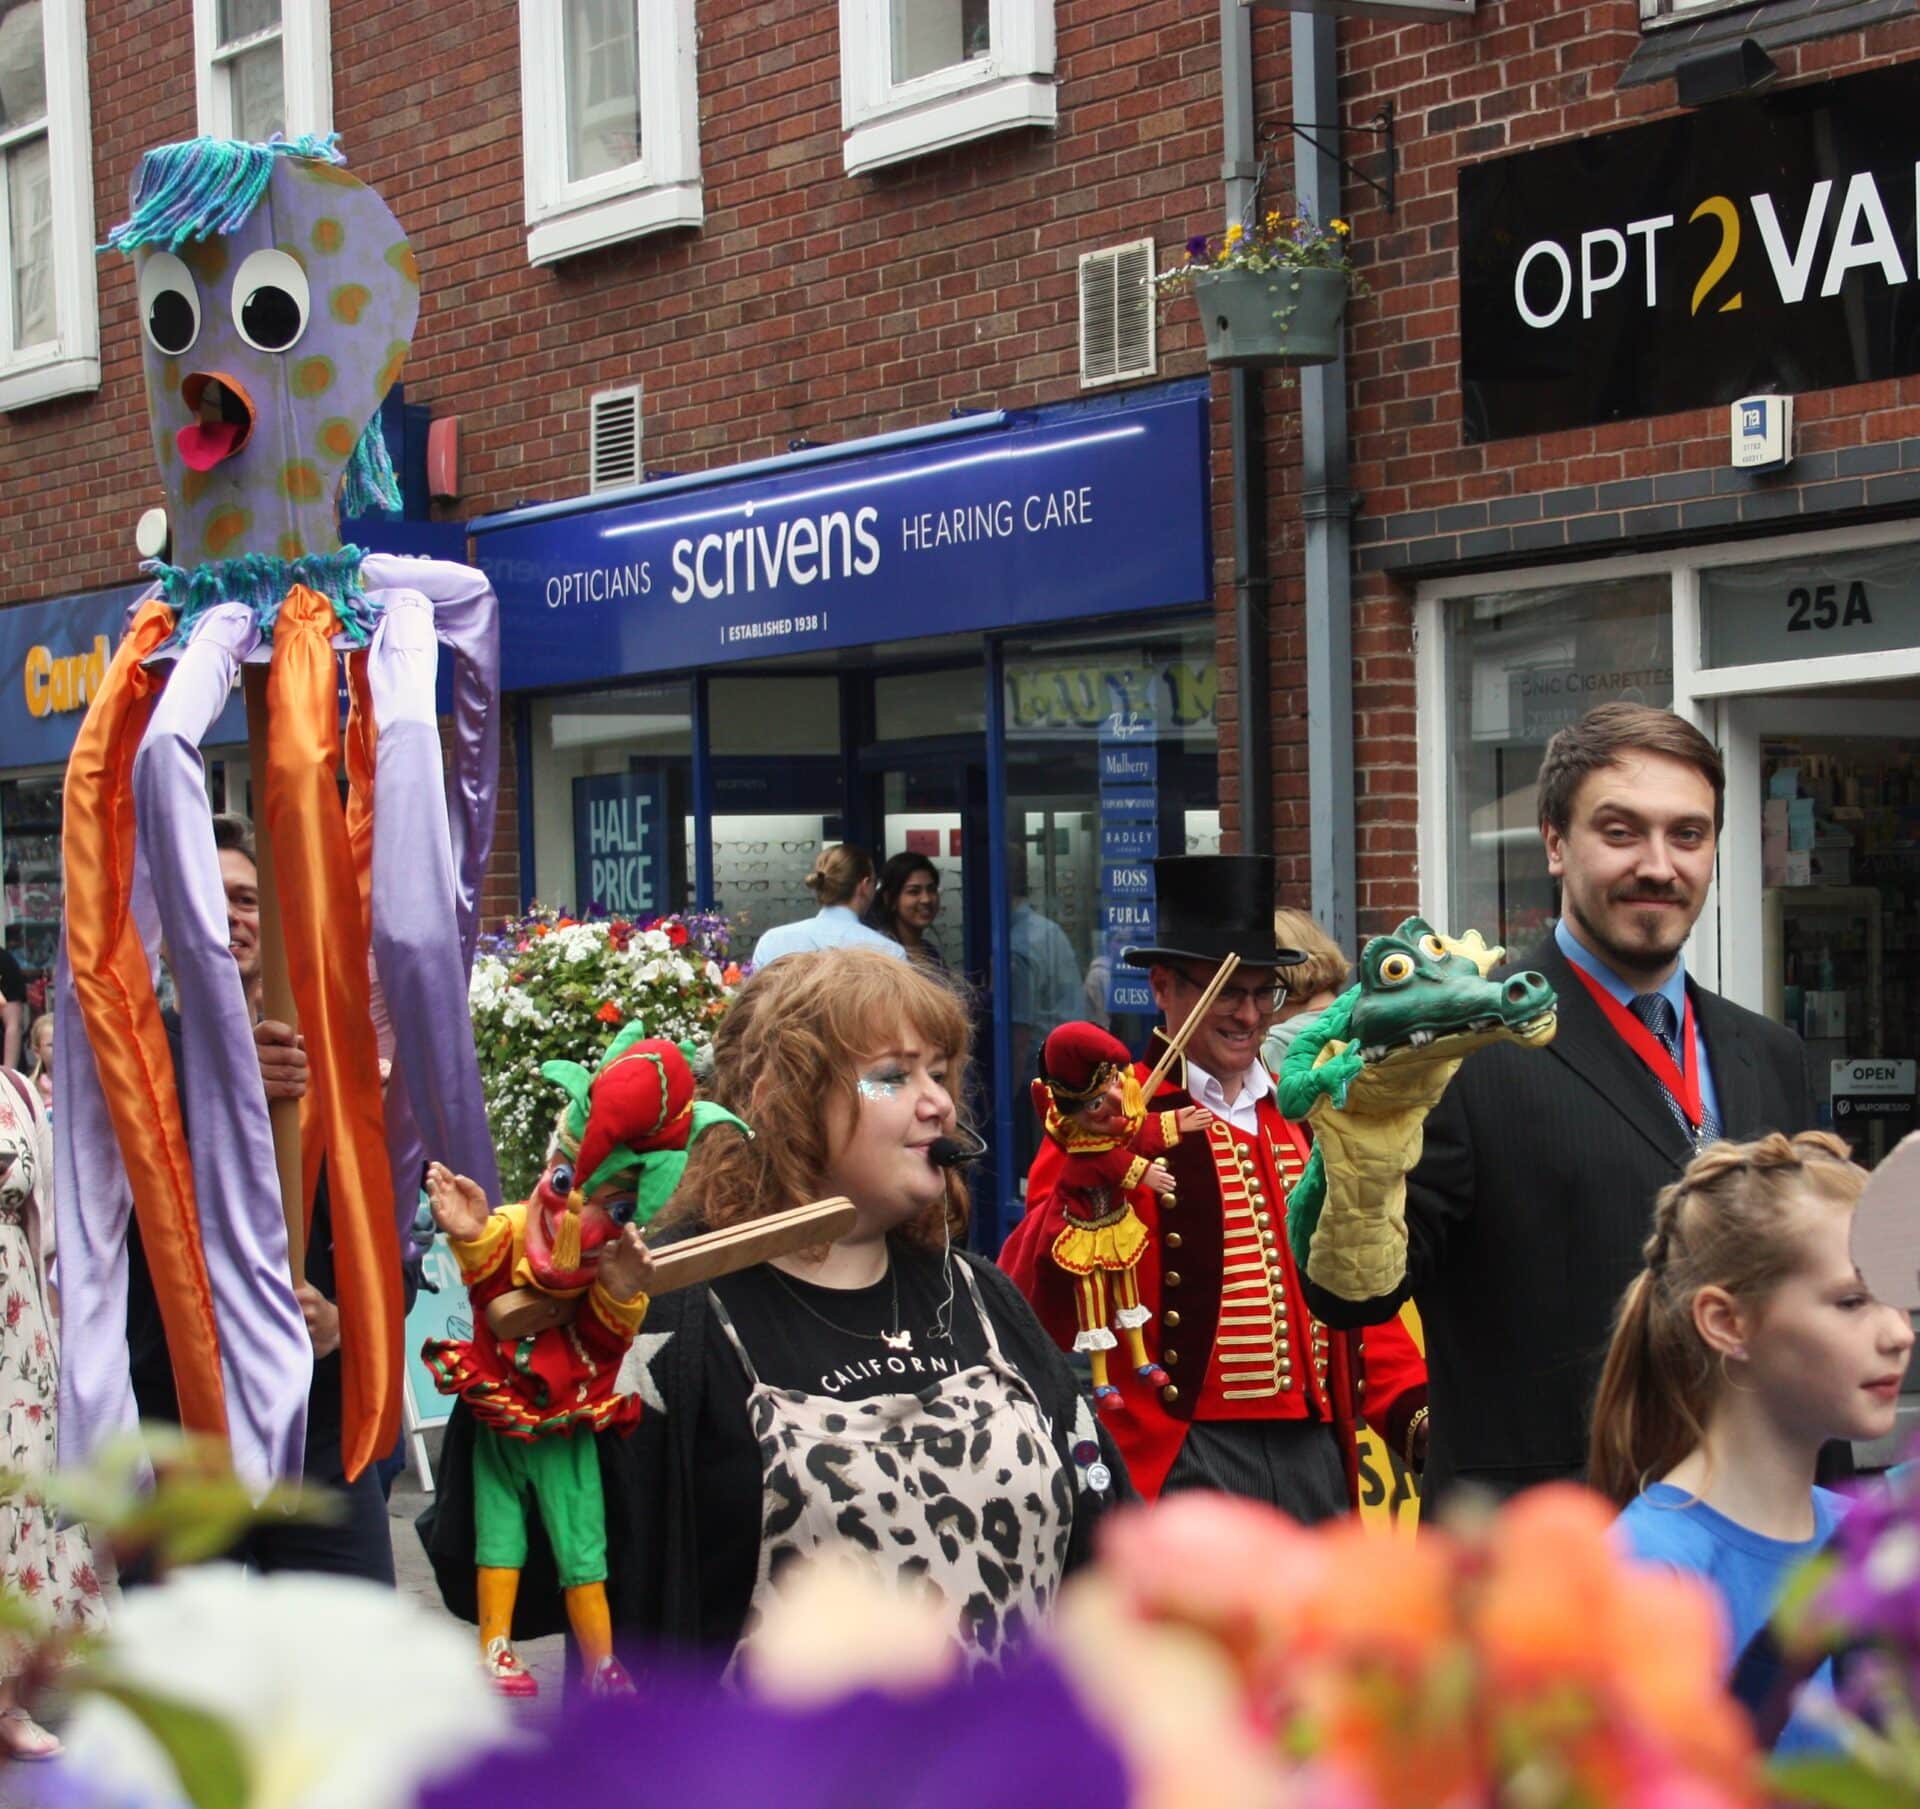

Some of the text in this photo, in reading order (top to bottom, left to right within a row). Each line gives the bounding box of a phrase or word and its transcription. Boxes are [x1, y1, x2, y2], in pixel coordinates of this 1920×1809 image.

[546, 561, 651, 608] OPTICIANS
[671, 500, 880, 604] scrivens
[903, 500, 1013, 551] HEARING
[1024, 487, 1093, 532] CARE
[1787, 580, 1873, 632] 25A
[728, 615, 818, 641] ESTABLISHED 1938
[25, 634, 111, 718] Card
[1106, 752, 1148, 777] Mulberry
[590, 795, 651, 854] HALF
[592, 856, 653, 911] PRICE
[1113, 869, 1148, 887] BOSS
[1108, 907, 1150, 923] FURLA
[1114, 987, 1149, 1006] GUESS
[1853, 1067, 1896, 1080] OPEN
[821, 1356, 961, 1393] CALIFORNI
